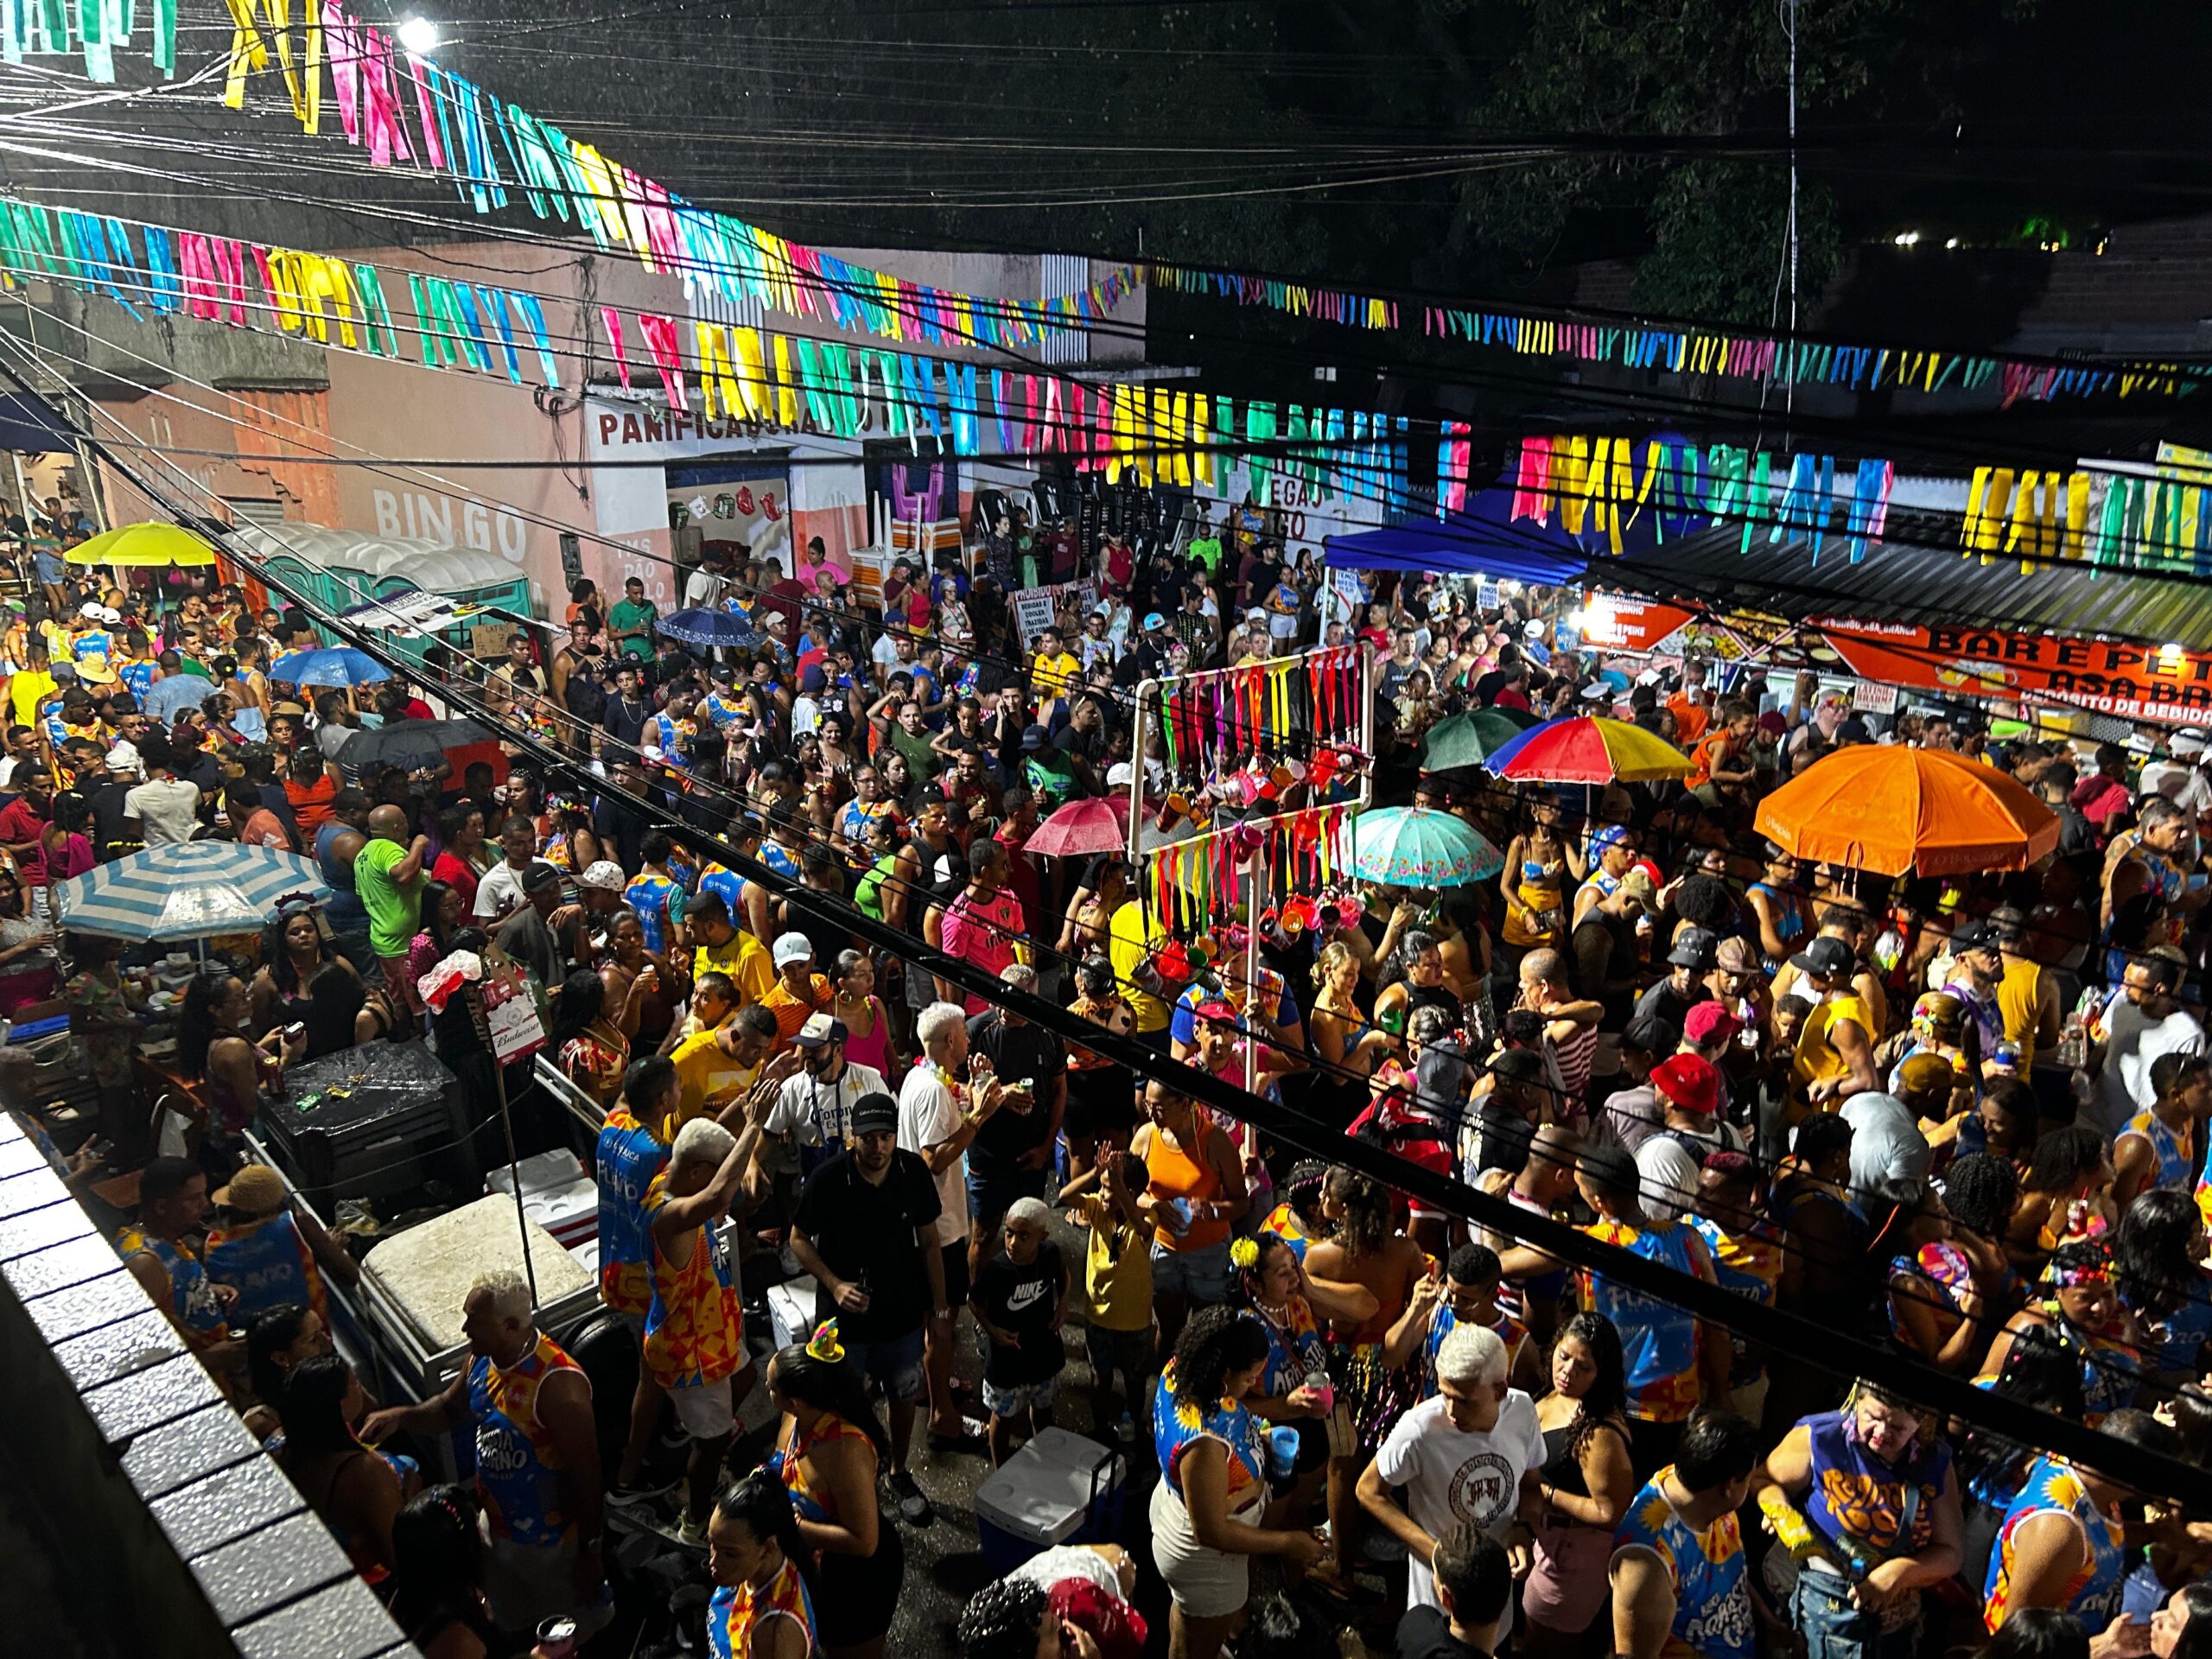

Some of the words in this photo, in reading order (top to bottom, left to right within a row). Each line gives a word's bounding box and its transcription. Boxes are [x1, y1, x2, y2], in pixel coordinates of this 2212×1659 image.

[599, 406, 817, 446] PANIFICADOA
[372, 488, 526, 563] BINGO
[1014, 584, 1052, 601] PROIBIDO
[1929, 629, 2041, 664] BAR
[2056, 641, 2090, 669] E
[2047, 669, 2138, 701] ASA
[2113, 698, 2141, 716] DE
[493, 1021, 540, 1048] Budweiser
[810, 1105, 853, 1125] Coron
[826, 1119, 849, 1129] Exra
[1013, 1279, 1044, 1301] NIKE
